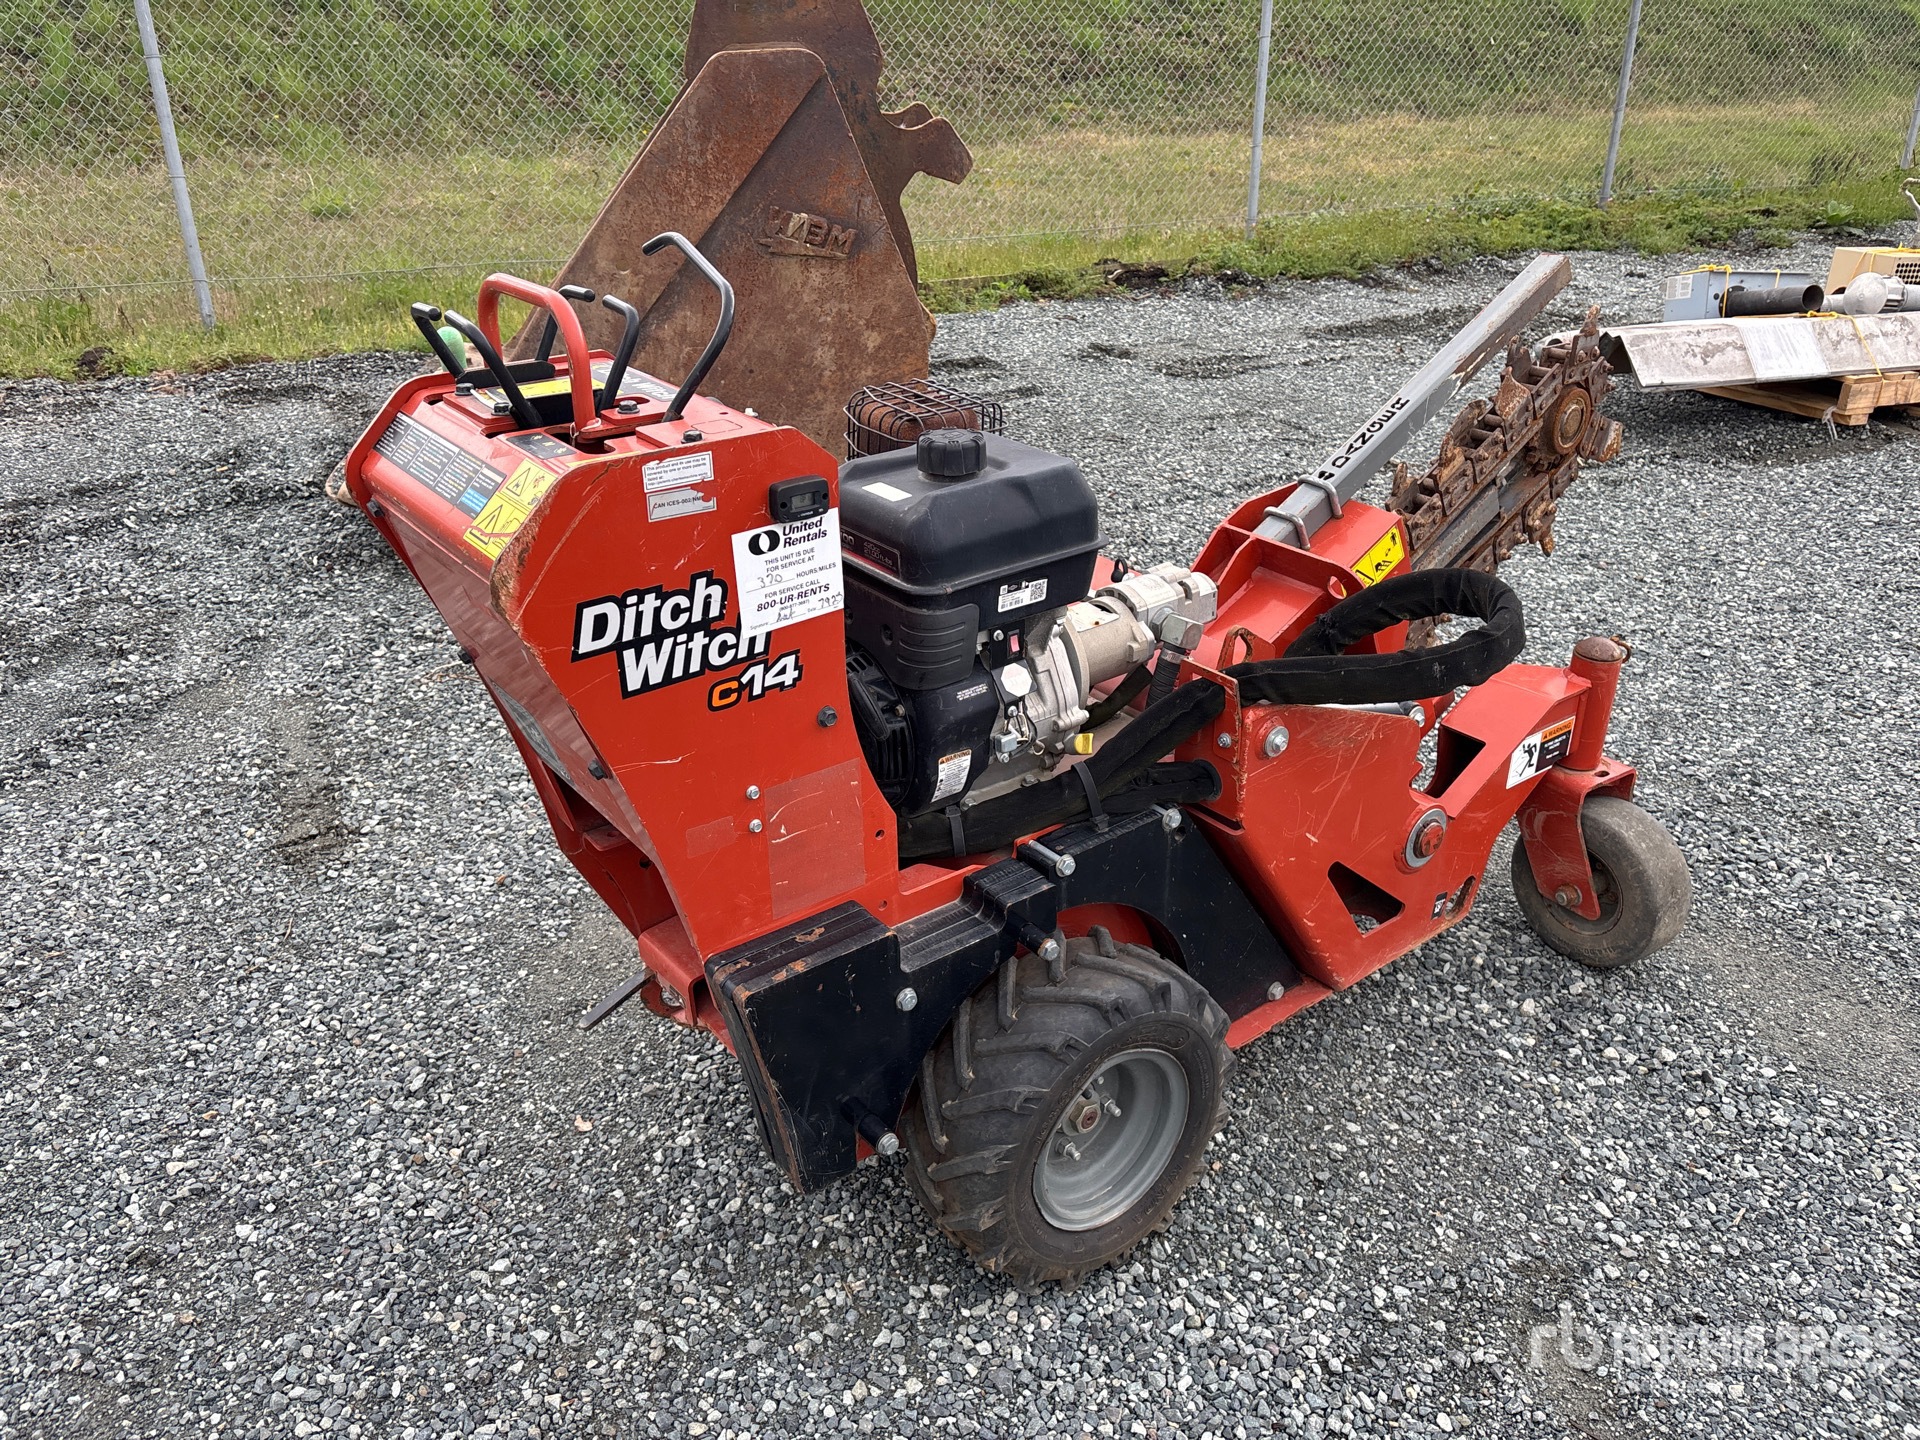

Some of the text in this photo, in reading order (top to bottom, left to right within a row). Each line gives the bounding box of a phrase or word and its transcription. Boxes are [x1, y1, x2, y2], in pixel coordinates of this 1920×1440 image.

[1331, 397, 1410, 468] DANGER
[782, 516, 823, 537] United
[783, 528, 828, 549] Rentals
[764, 557, 779, 566] THIS
[779, 553, 795, 562] UNIT
[802, 547, 815, 556] DUE
[766, 565, 780, 573] FOR
[780, 557, 806, 570] SERVICE
[756, 583, 830, 612] 800-UR-RENTS
[764, 579, 820, 599] FOR SERVICE CALL
[578, 577, 723, 655] Ditch
[1548, 722, 1572, 737] WARNING
[944, 750, 971, 763] WARNING
